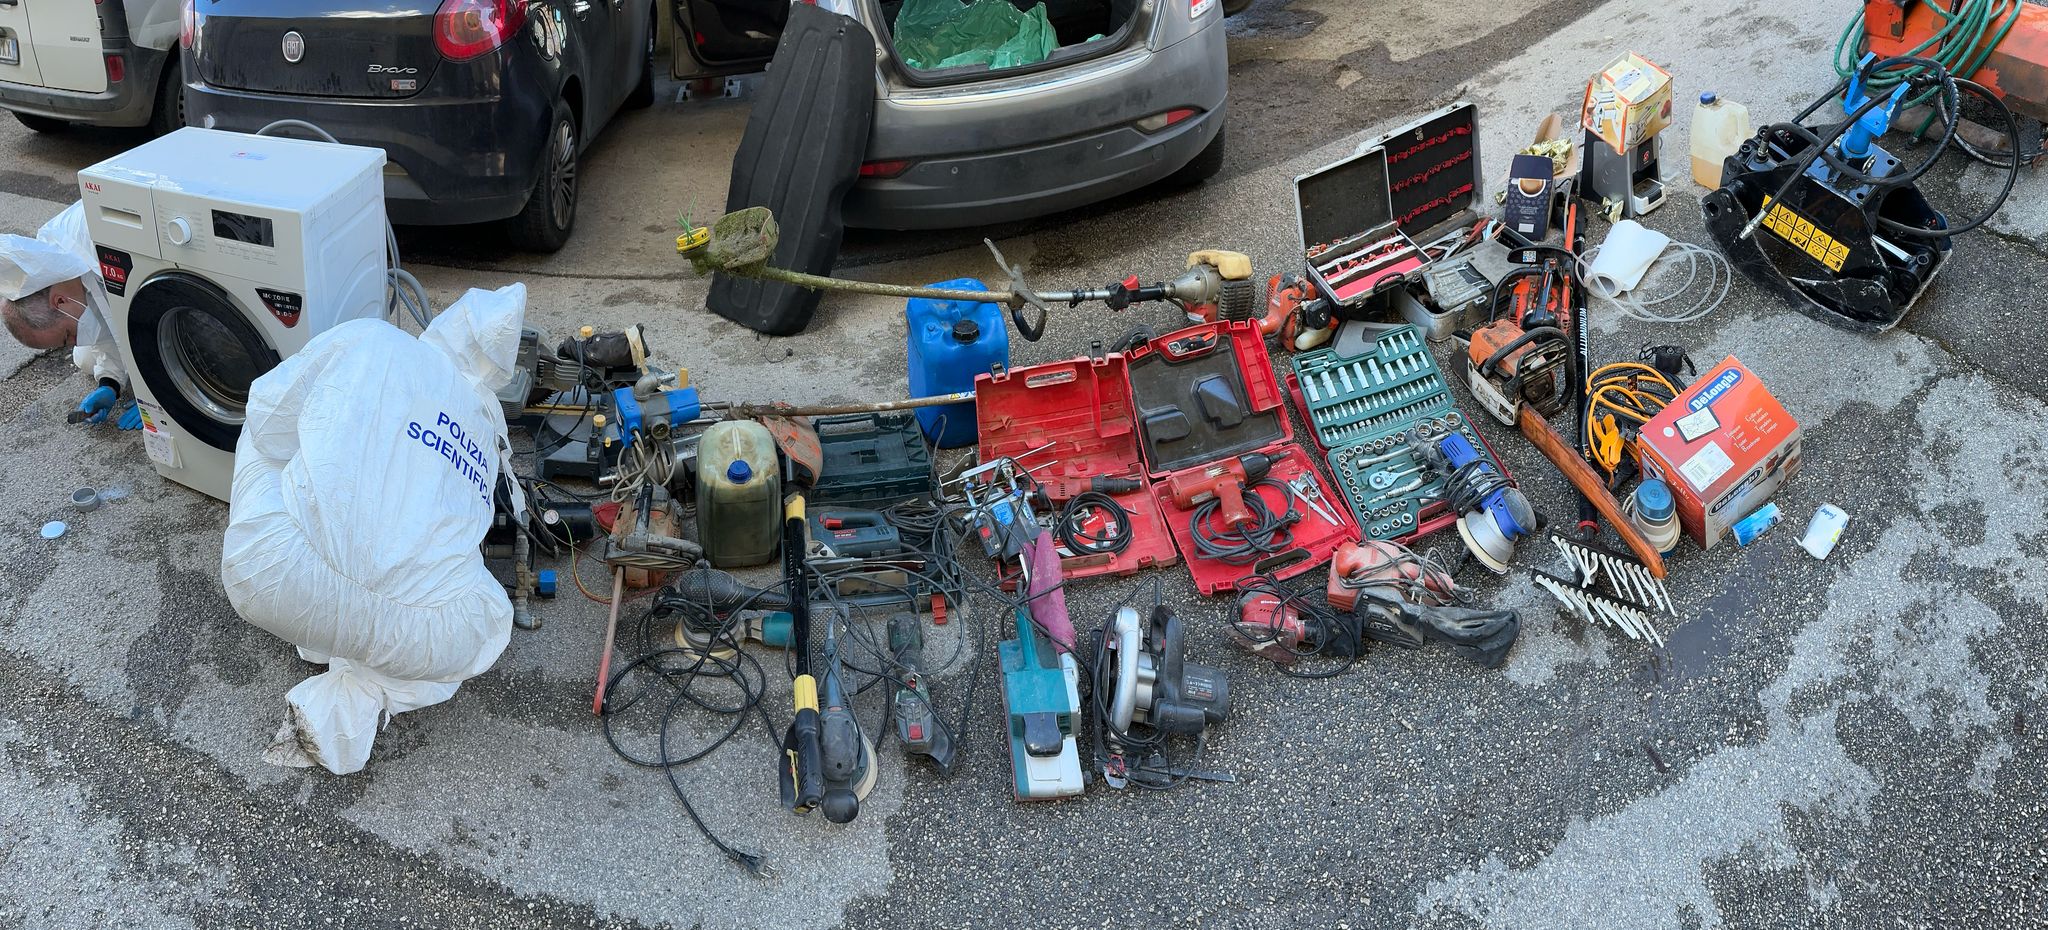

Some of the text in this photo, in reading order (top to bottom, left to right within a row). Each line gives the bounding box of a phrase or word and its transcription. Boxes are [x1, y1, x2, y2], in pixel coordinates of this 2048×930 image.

[286, 40, 301, 55] FIAT
[367, 64, 418, 74] Bravo
[85, 182, 101, 192] AKAI
[103, 253, 121, 263] AKAI
[103, 265, 117, 278] 7.0
[437, 411, 489, 474] POLIZIA
[407, 421, 491, 511] SCIENTIFICA
